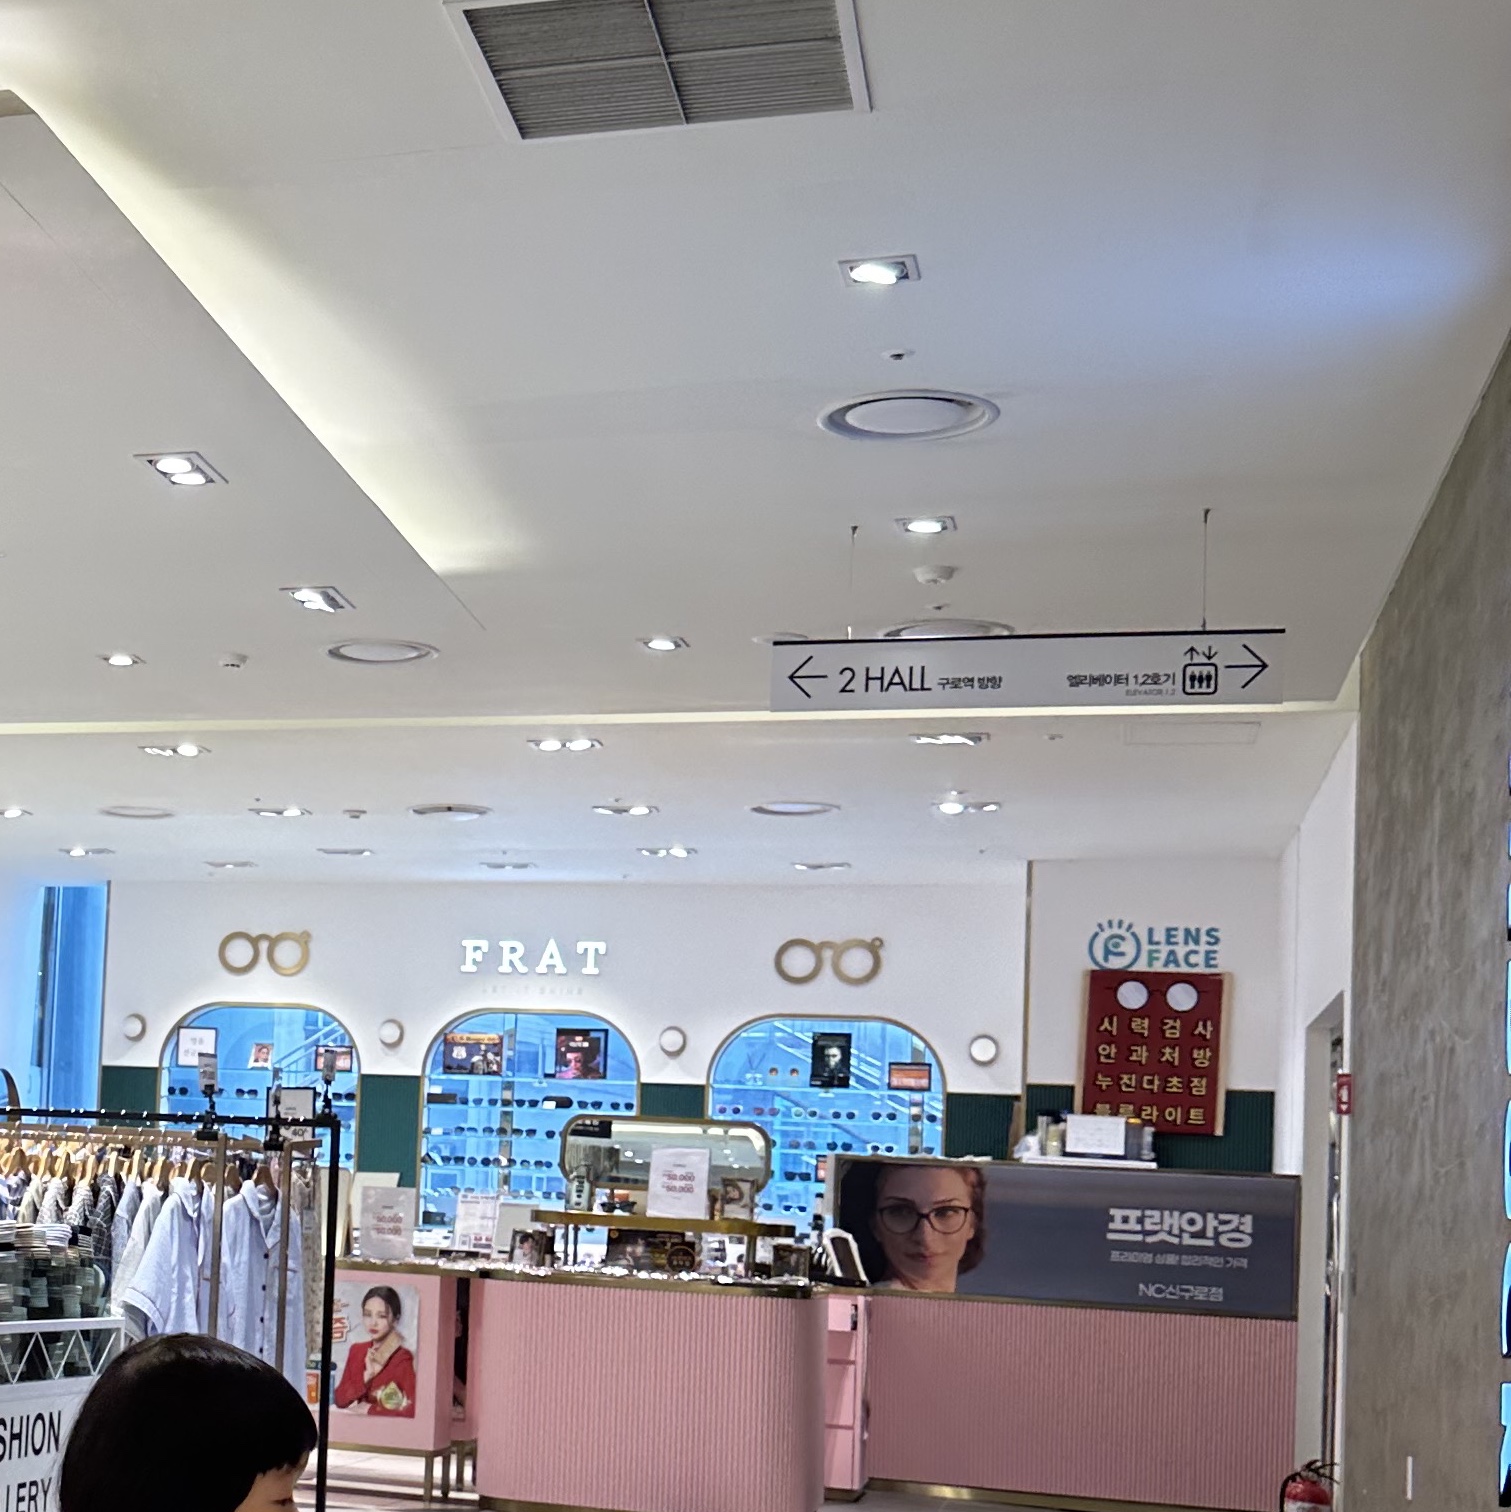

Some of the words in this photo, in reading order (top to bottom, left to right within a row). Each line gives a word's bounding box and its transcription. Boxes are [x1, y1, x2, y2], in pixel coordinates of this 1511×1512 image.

[839, 667, 855, 693] 2
[865, 666, 932, 692] HALL
[1147, 927, 1220, 946] LENS
[460, 937, 607, 975] FRAT
[1147, 949, 1218, 968] FACE
[1098, 1015, 1213, 1039] 시력검사
[1097, 1043, 1212, 1068] 안과처방
[1095, 1073, 1207, 1095] 누진다초점
[1106, 1208, 1253, 1248] 프랫안경
[1139, 1283, 1223, 1302] NC신구로점
